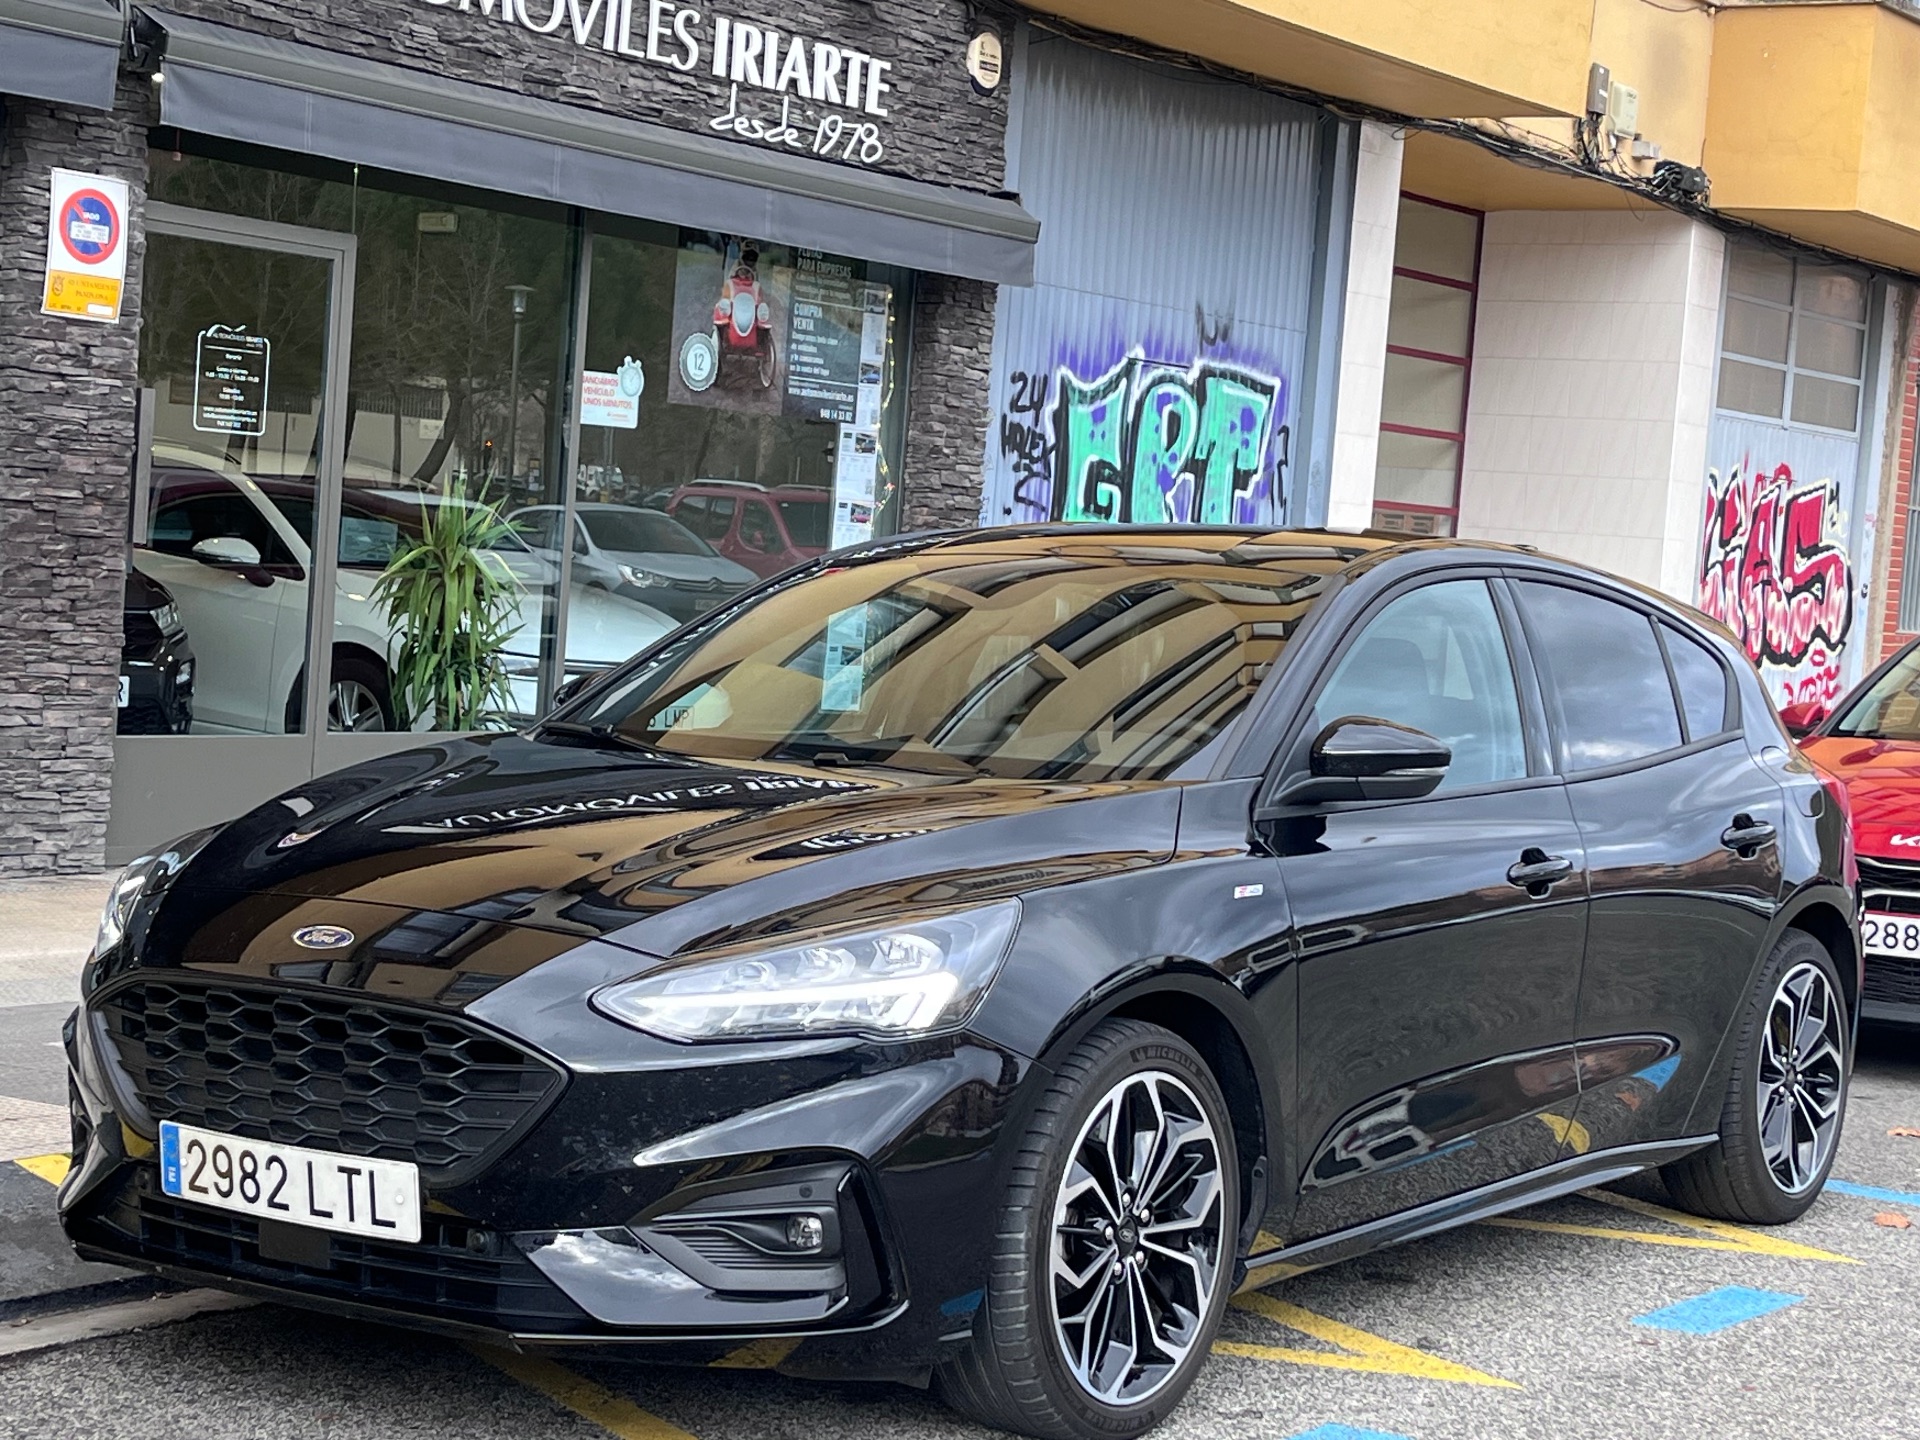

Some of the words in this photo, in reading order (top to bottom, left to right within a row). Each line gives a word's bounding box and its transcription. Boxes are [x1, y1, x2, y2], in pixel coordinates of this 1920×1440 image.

[711, 16, 892, 118] IRIARTE
[709, 81, 808, 148] desde
[811, 114, 884, 163] 1978
[694, 352, 705, 371] 12
[1864, 919, 1919, 951] 288
[186, 1138, 290, 1212] 2982
[306, 1159, 397, 1229] LTL
